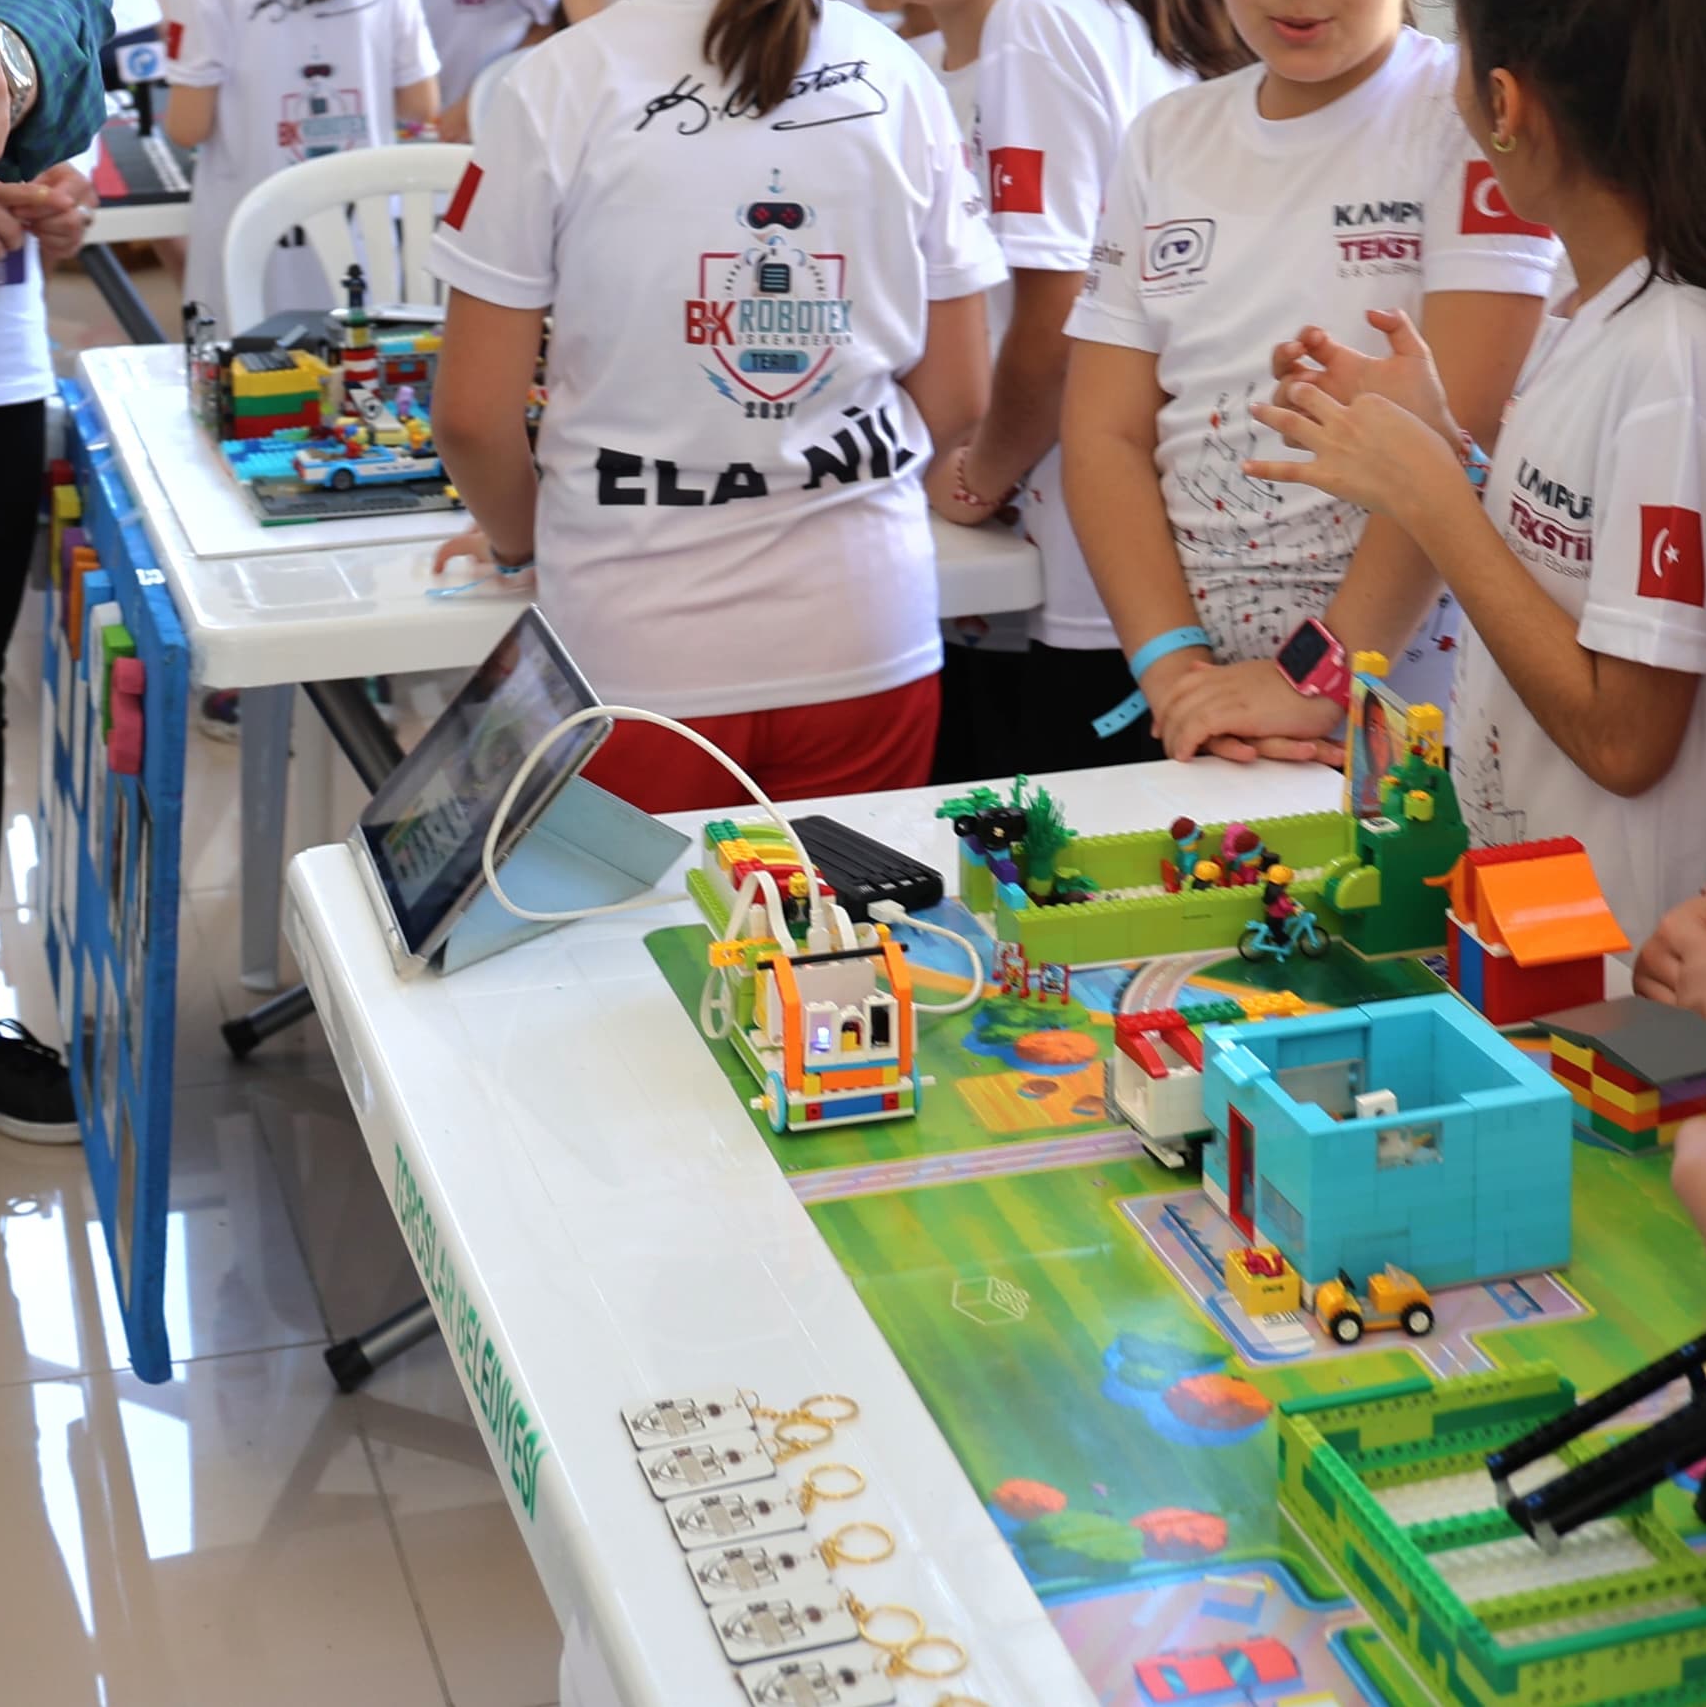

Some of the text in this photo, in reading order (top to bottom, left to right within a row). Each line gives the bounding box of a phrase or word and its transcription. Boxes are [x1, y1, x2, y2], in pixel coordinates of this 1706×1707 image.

[685, 299, 853, 346] BK ROBOTEX
[595, 447, 769, 506] ELA
